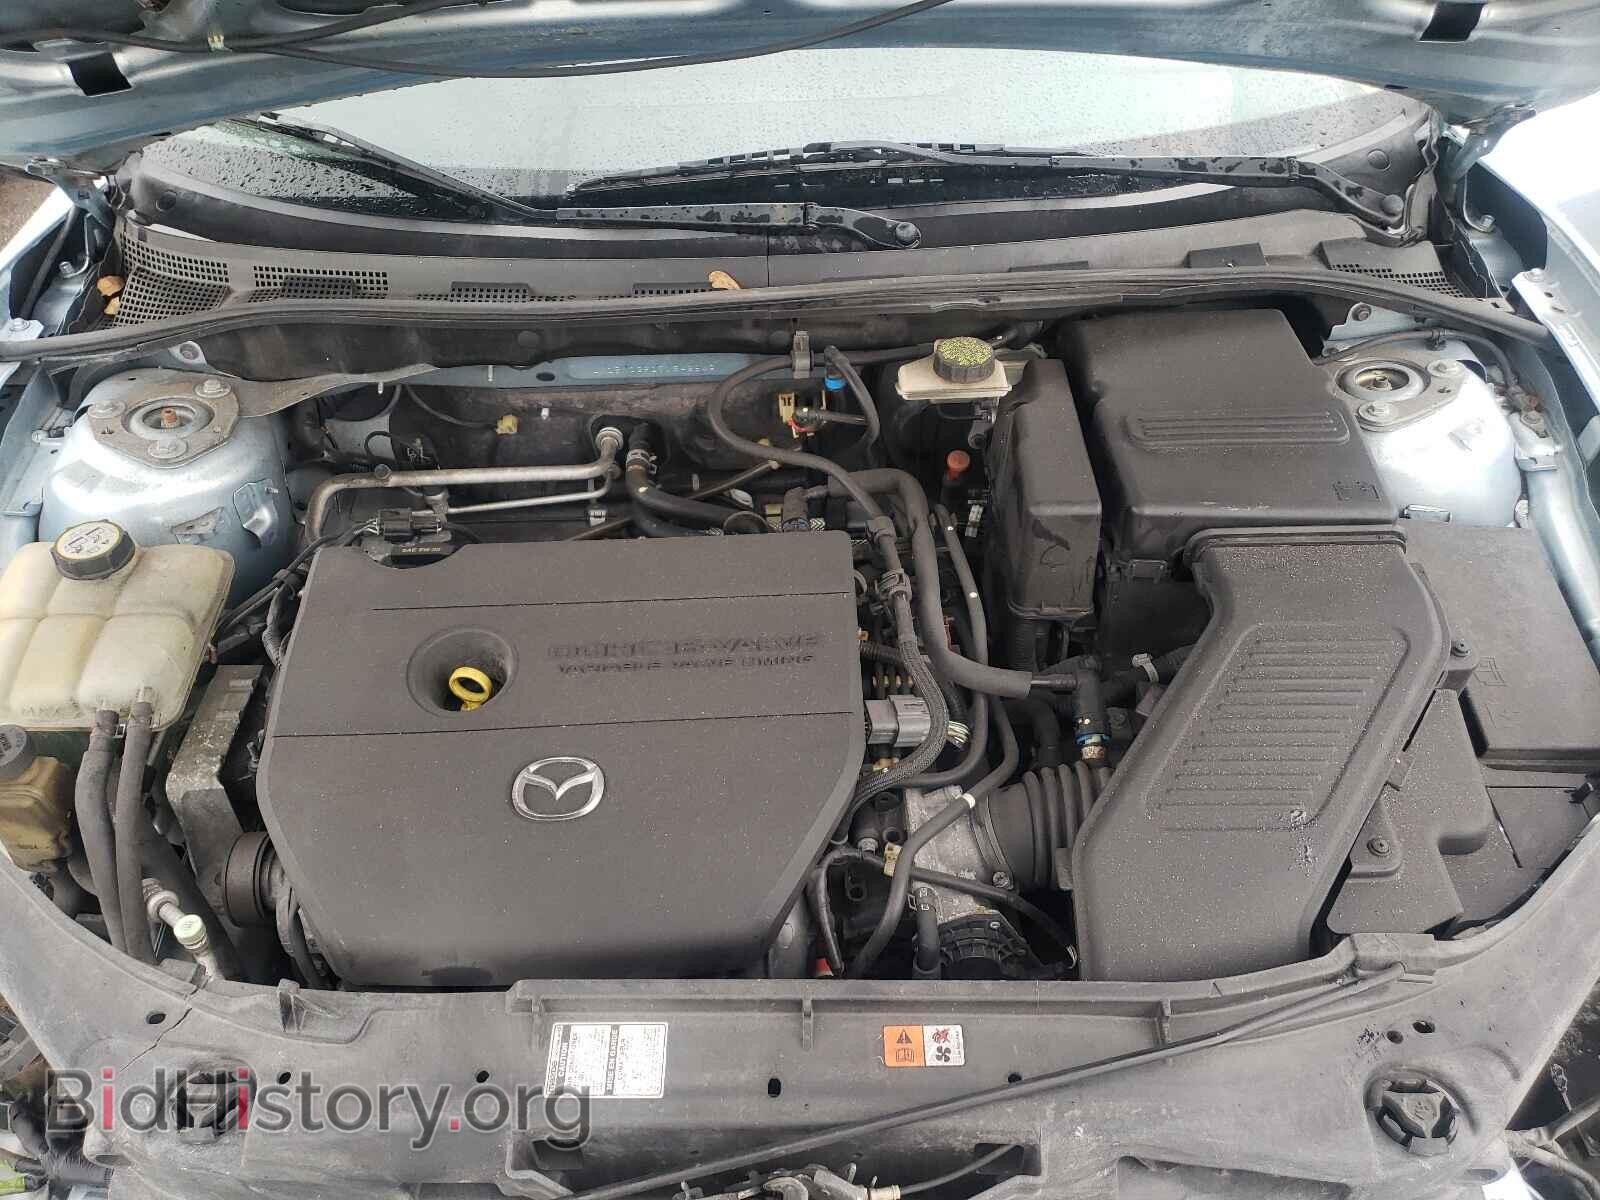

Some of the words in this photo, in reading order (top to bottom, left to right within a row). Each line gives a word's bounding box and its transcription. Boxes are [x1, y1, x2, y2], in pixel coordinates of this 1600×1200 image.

[609, 1029, 619, 1057] GARDE
[558, 1042, 569, 1078] CAUTION
[608, 1057, 617, 1068] EN
[606, 1070, 616, 1091] MISE
